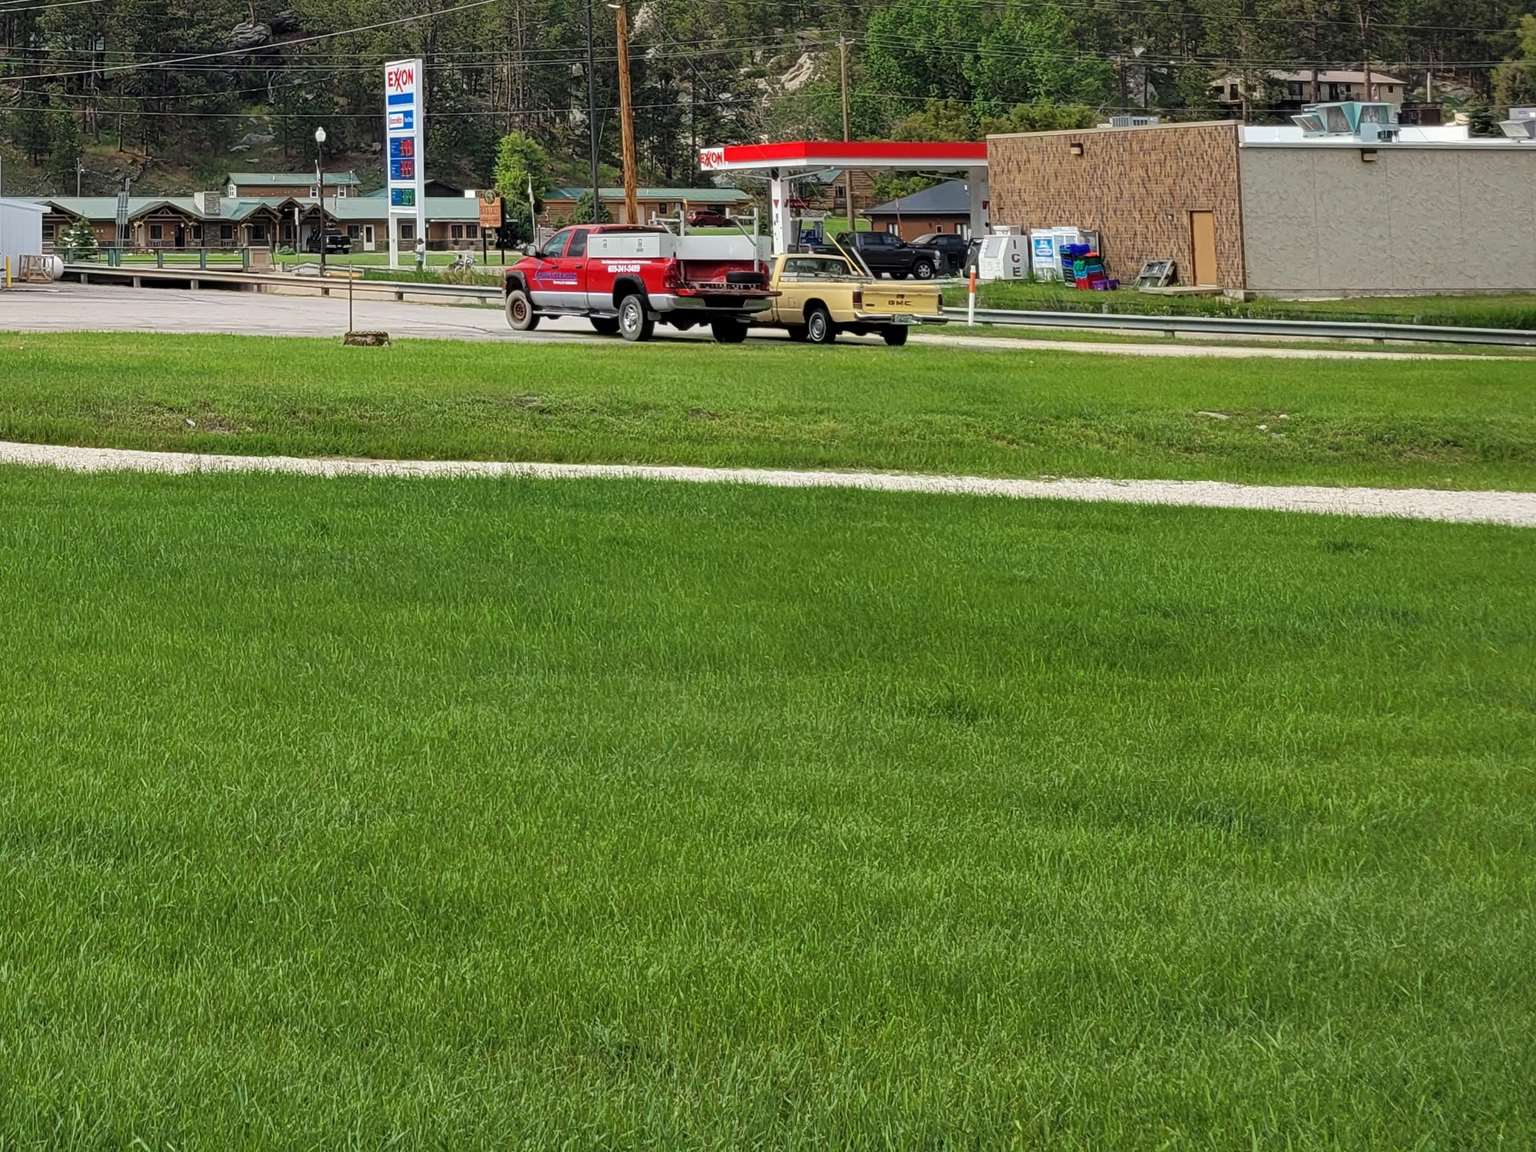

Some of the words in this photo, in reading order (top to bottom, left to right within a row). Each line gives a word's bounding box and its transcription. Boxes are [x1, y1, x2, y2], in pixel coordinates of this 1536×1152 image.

[388, 68, 414, 93] EXXON
[698, 151, 723, 167] EXXON
[1011, 239, 1022, 278] ICE
